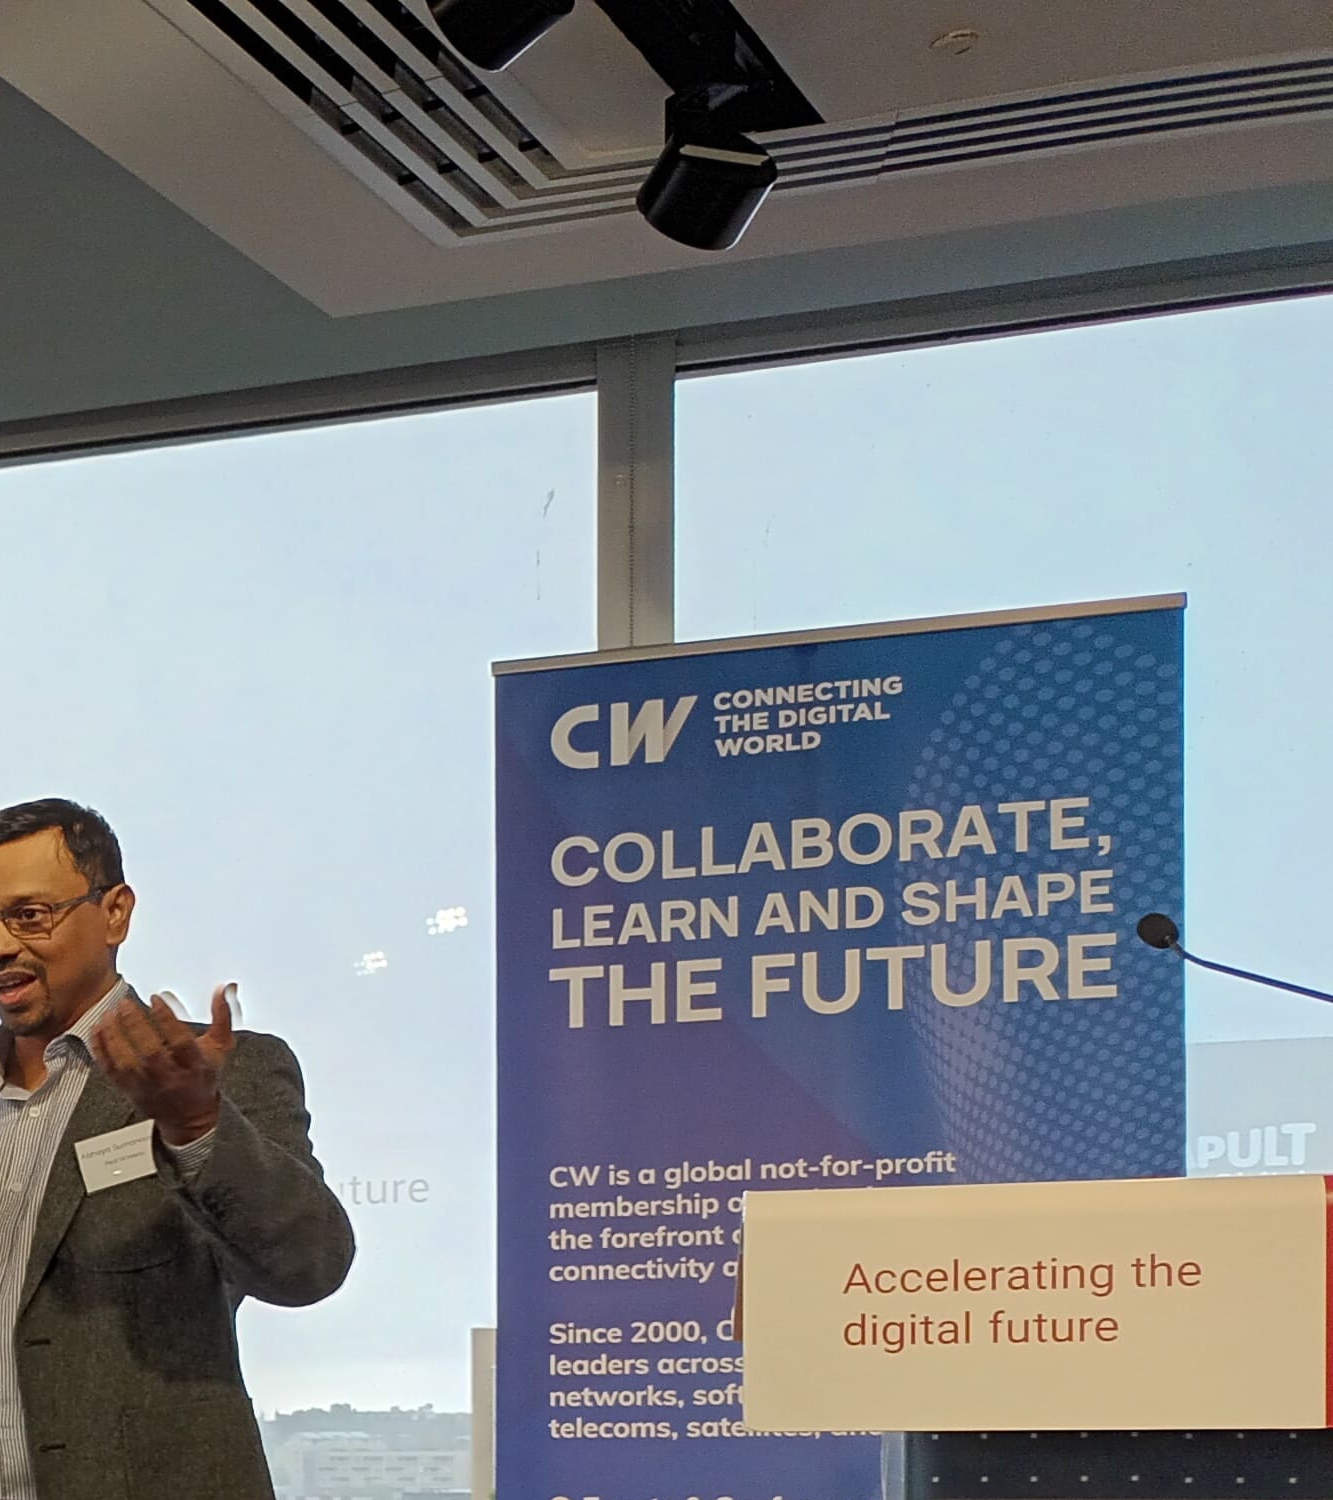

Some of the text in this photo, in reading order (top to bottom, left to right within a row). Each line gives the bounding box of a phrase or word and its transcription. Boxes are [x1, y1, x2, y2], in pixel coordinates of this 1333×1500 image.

[713, 675, 904, 711] CONNECTING
[550, 694, 697, 769] CW
[714, 700, 891, 732] THE DIGITAL
[715, 731, 821, 757] WORLD
[550, 796, 1113, 887] COLLABORATE,
[551, 868, 1114, 949] LEARN AND SHAPE
[548, 932, 1118, 1029] THE FUTURE
[549, 1151, 956, 1189] CW is a global not-for-profit
[549, 1192, 720, 1220] membership
[549, 1229, 594, 1251] the
[599, 1225, 725, 1249] forefront
[549, 1257, 715, 1283] connectivity
[843, 1254, 1203, 1297] Accelerating the
[549, 1323, 623, 1345] Since
[630, 1321, 708, 1345] 2000,
[844, 1311, 1120, 1354] digital future
[549, 1354, 744, 1376] leaders across
[549, 1386, 684, 1410] networks,
[549, 1418, 678, 1441] telecoms,
